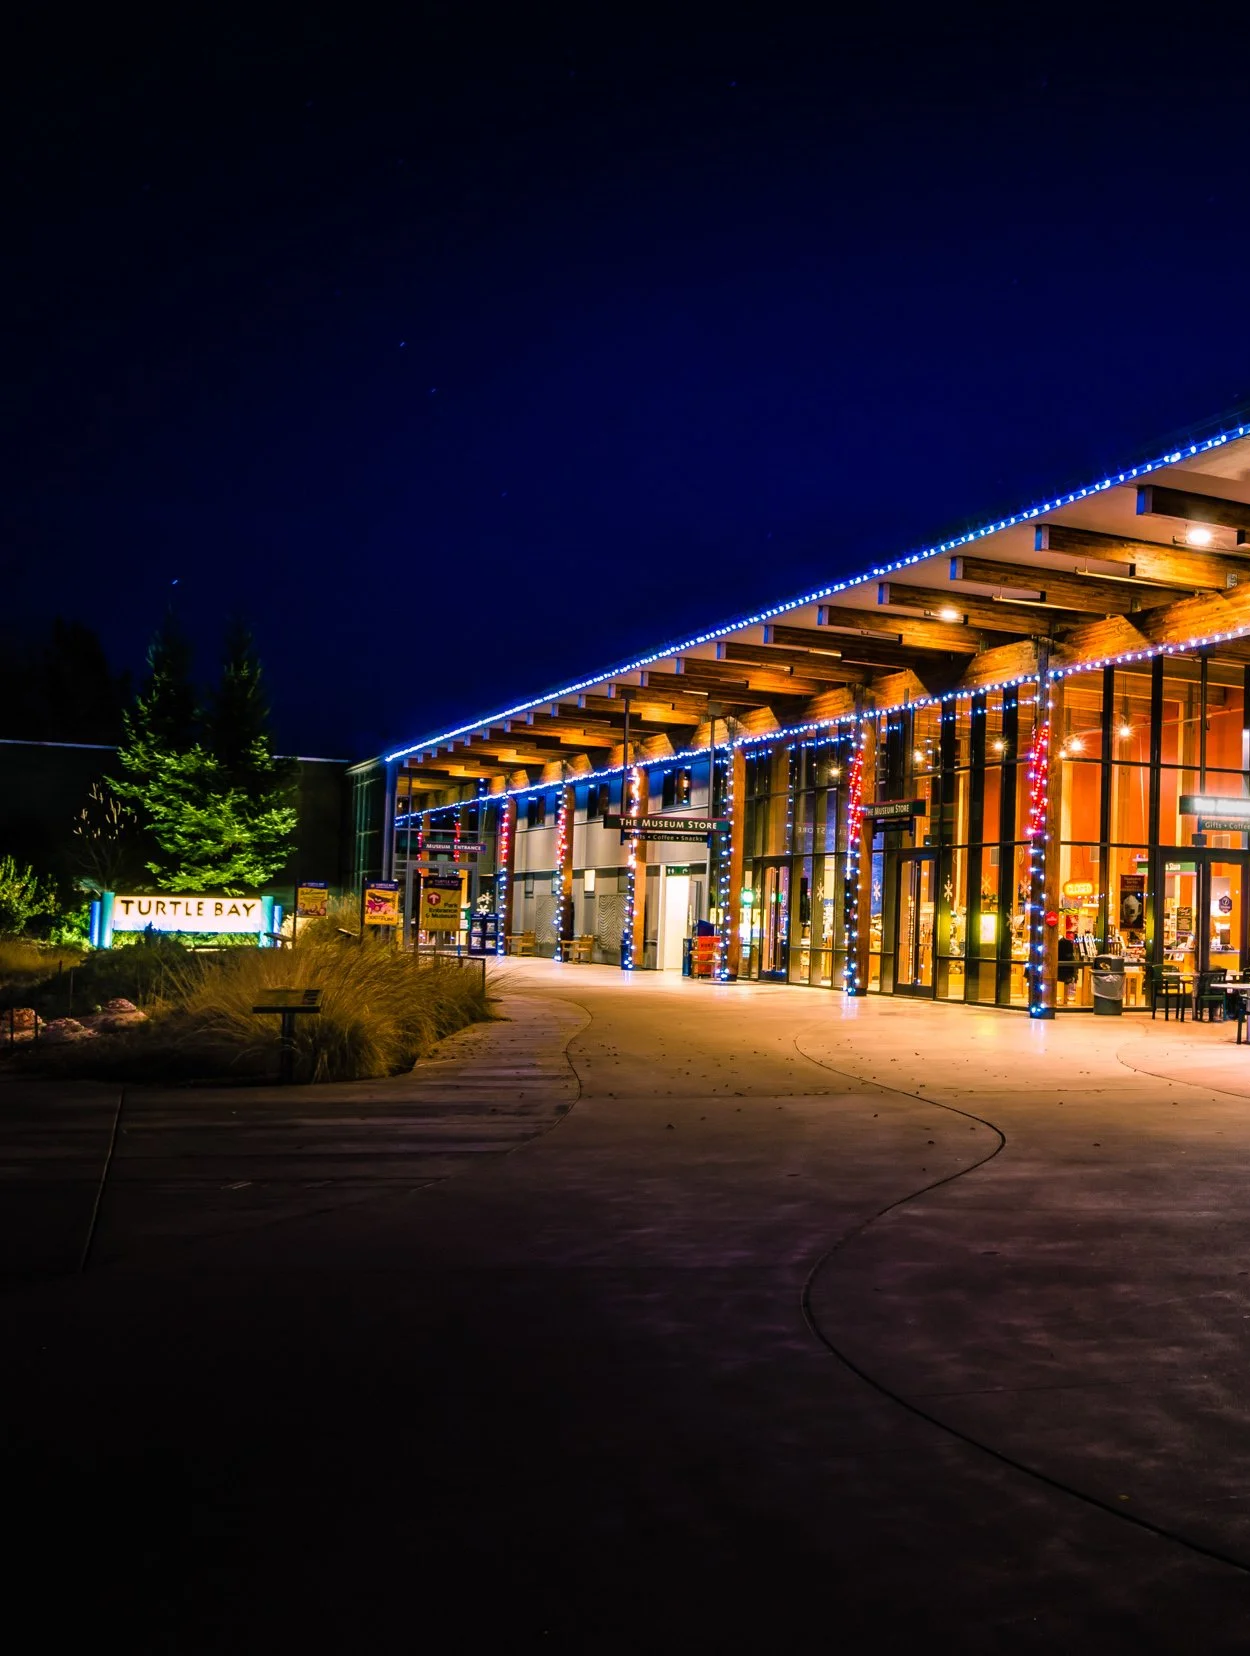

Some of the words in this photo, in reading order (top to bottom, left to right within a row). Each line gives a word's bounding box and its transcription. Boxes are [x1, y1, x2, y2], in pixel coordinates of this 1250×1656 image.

[866, 808, 874, 816] THE
[875, 806, 894, 815] MUSEUM
[896, 804, 909, 813] STORE
[620, 818, 637, 826] THE
[642, 820, 684, 828] MUSEUM
[688, 821, 717, 829] STORE
[121, 900, 204, 916] TURTLE
[214, 902, 255, 917] BAY
